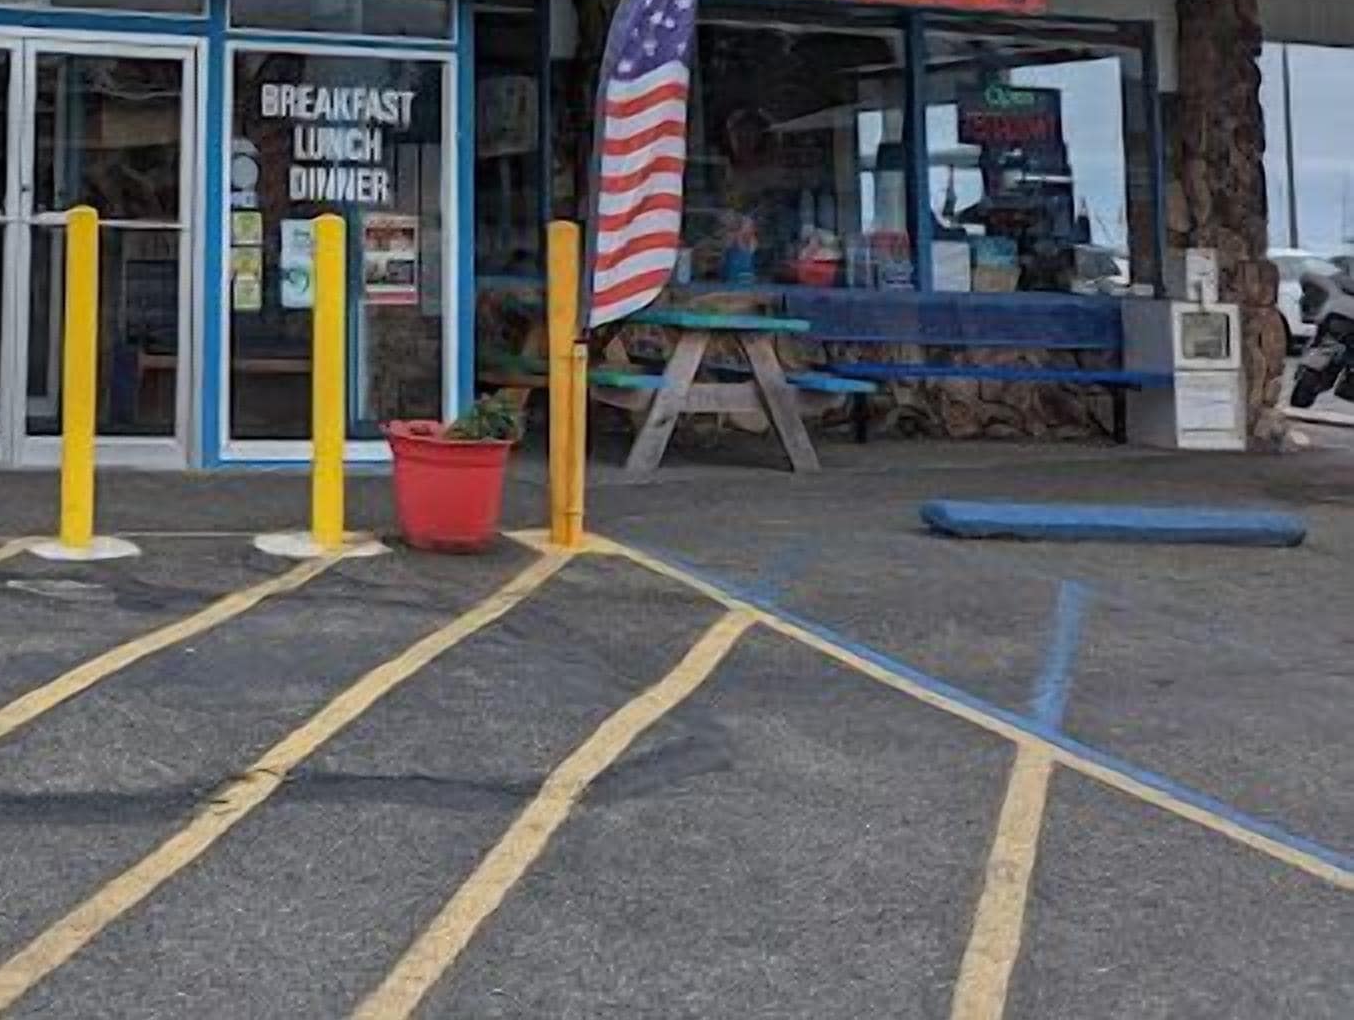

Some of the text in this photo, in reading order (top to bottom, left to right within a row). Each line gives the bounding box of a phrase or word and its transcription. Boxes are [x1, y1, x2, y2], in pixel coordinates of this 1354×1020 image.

[261, 83, 415, 131] BREAKFAST
[293, 125, 383, 162] LUNCH
[288, 164, 391, 202] DINNER
